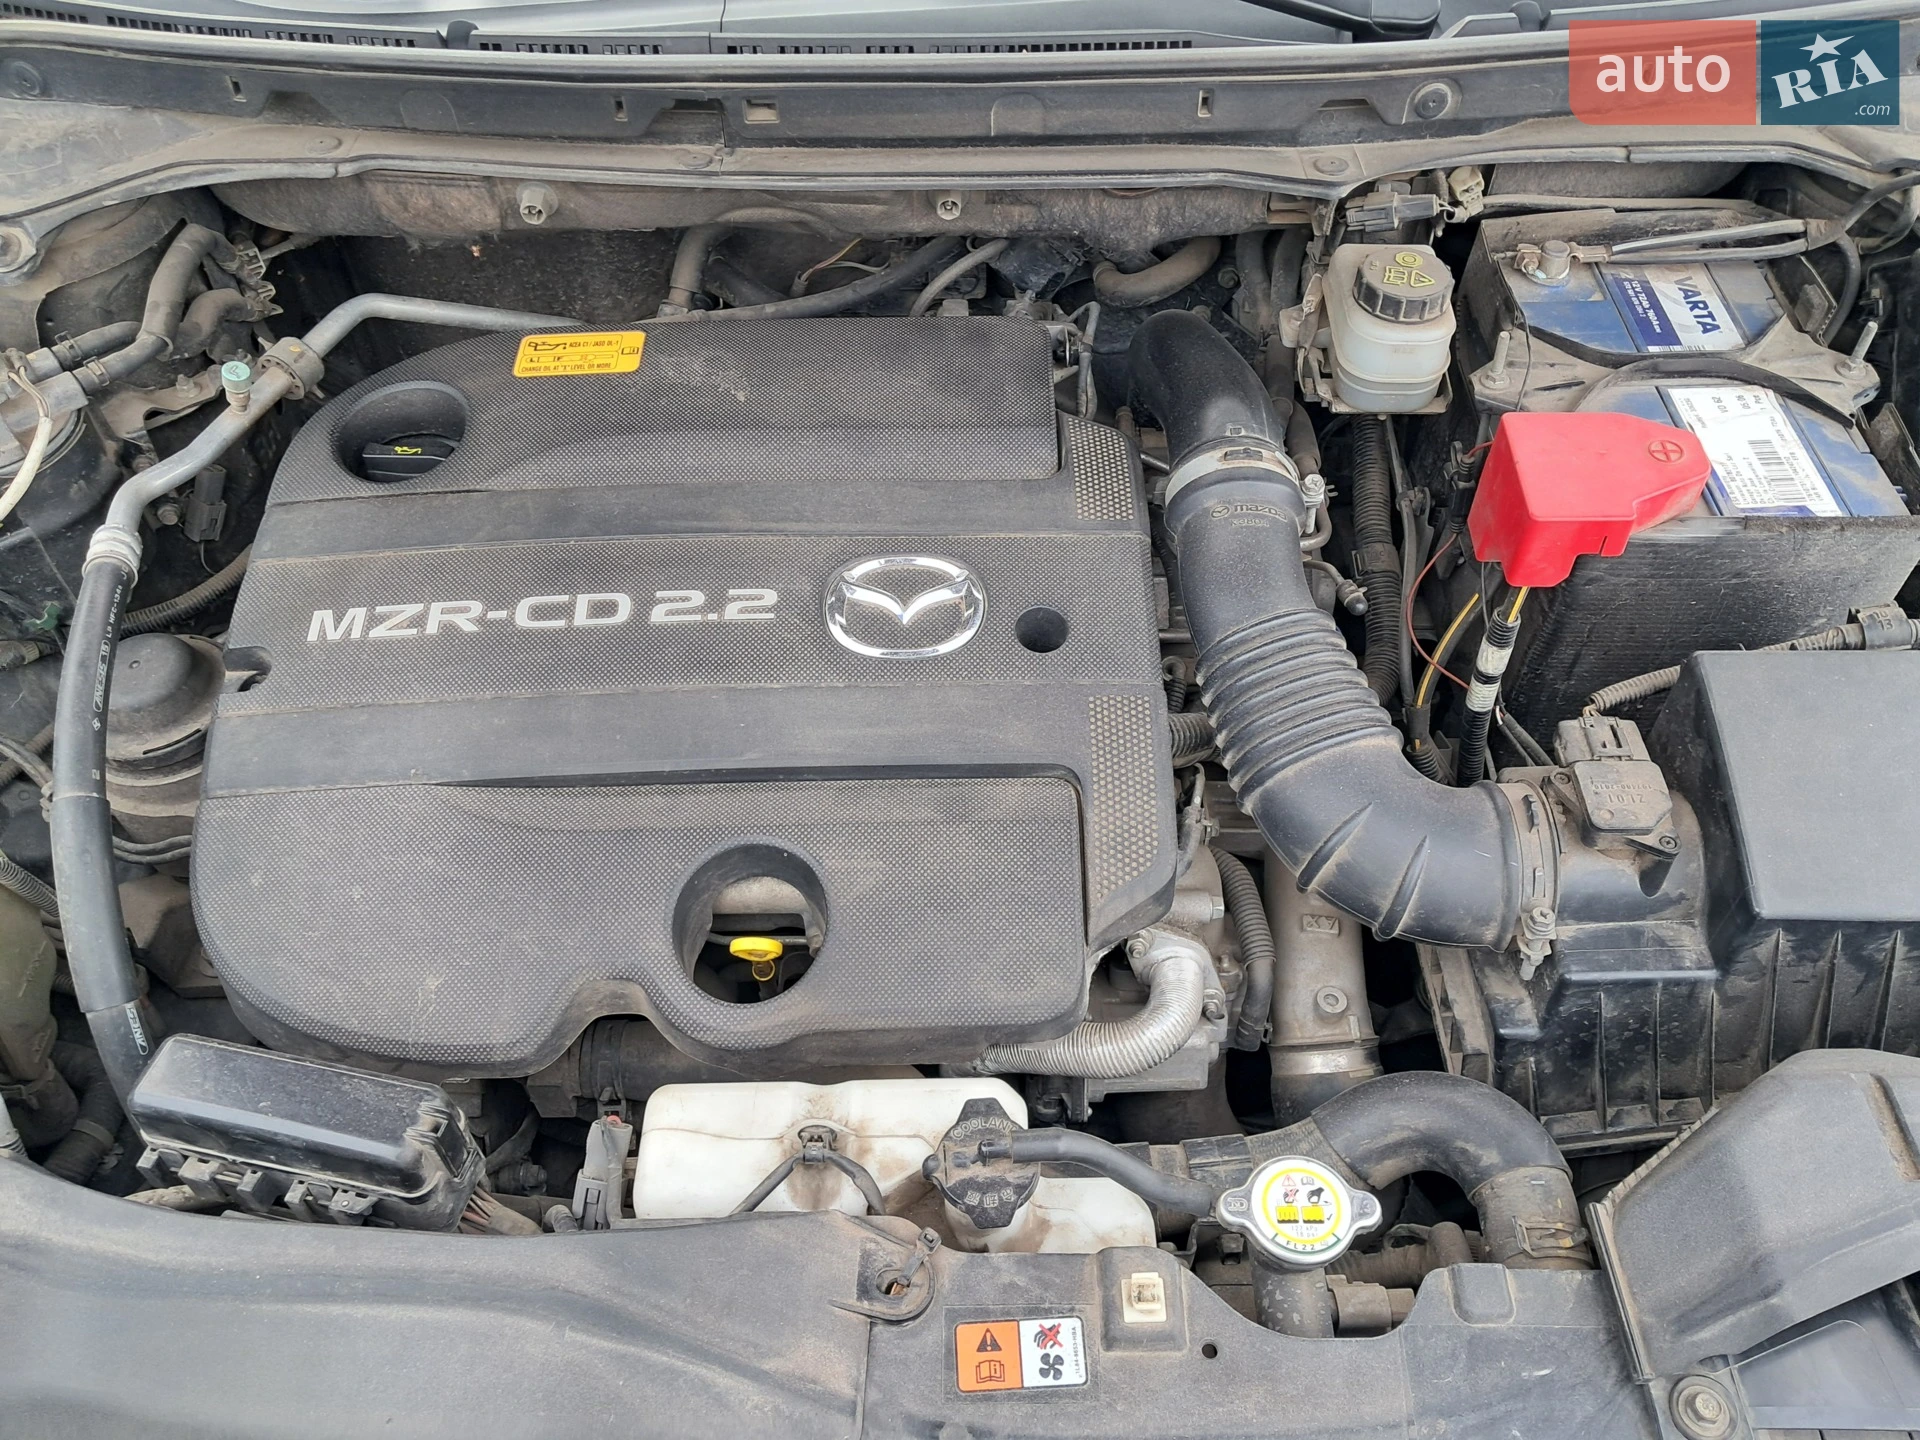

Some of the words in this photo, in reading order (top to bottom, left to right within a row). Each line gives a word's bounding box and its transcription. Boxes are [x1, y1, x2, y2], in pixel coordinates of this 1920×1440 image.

[1674, 276, 1722, 335] VARTA
[521, 365, 541, 373] CHANGE
[1234, 503, 1288, 521] mazda
[306, 592, 632, 642] MZR-CD
[650, 588, 780, 623] 2.2
[952, 1117, 1018, 1139] COOLANT
[1286, 1240, 1316, 1250] FL22
